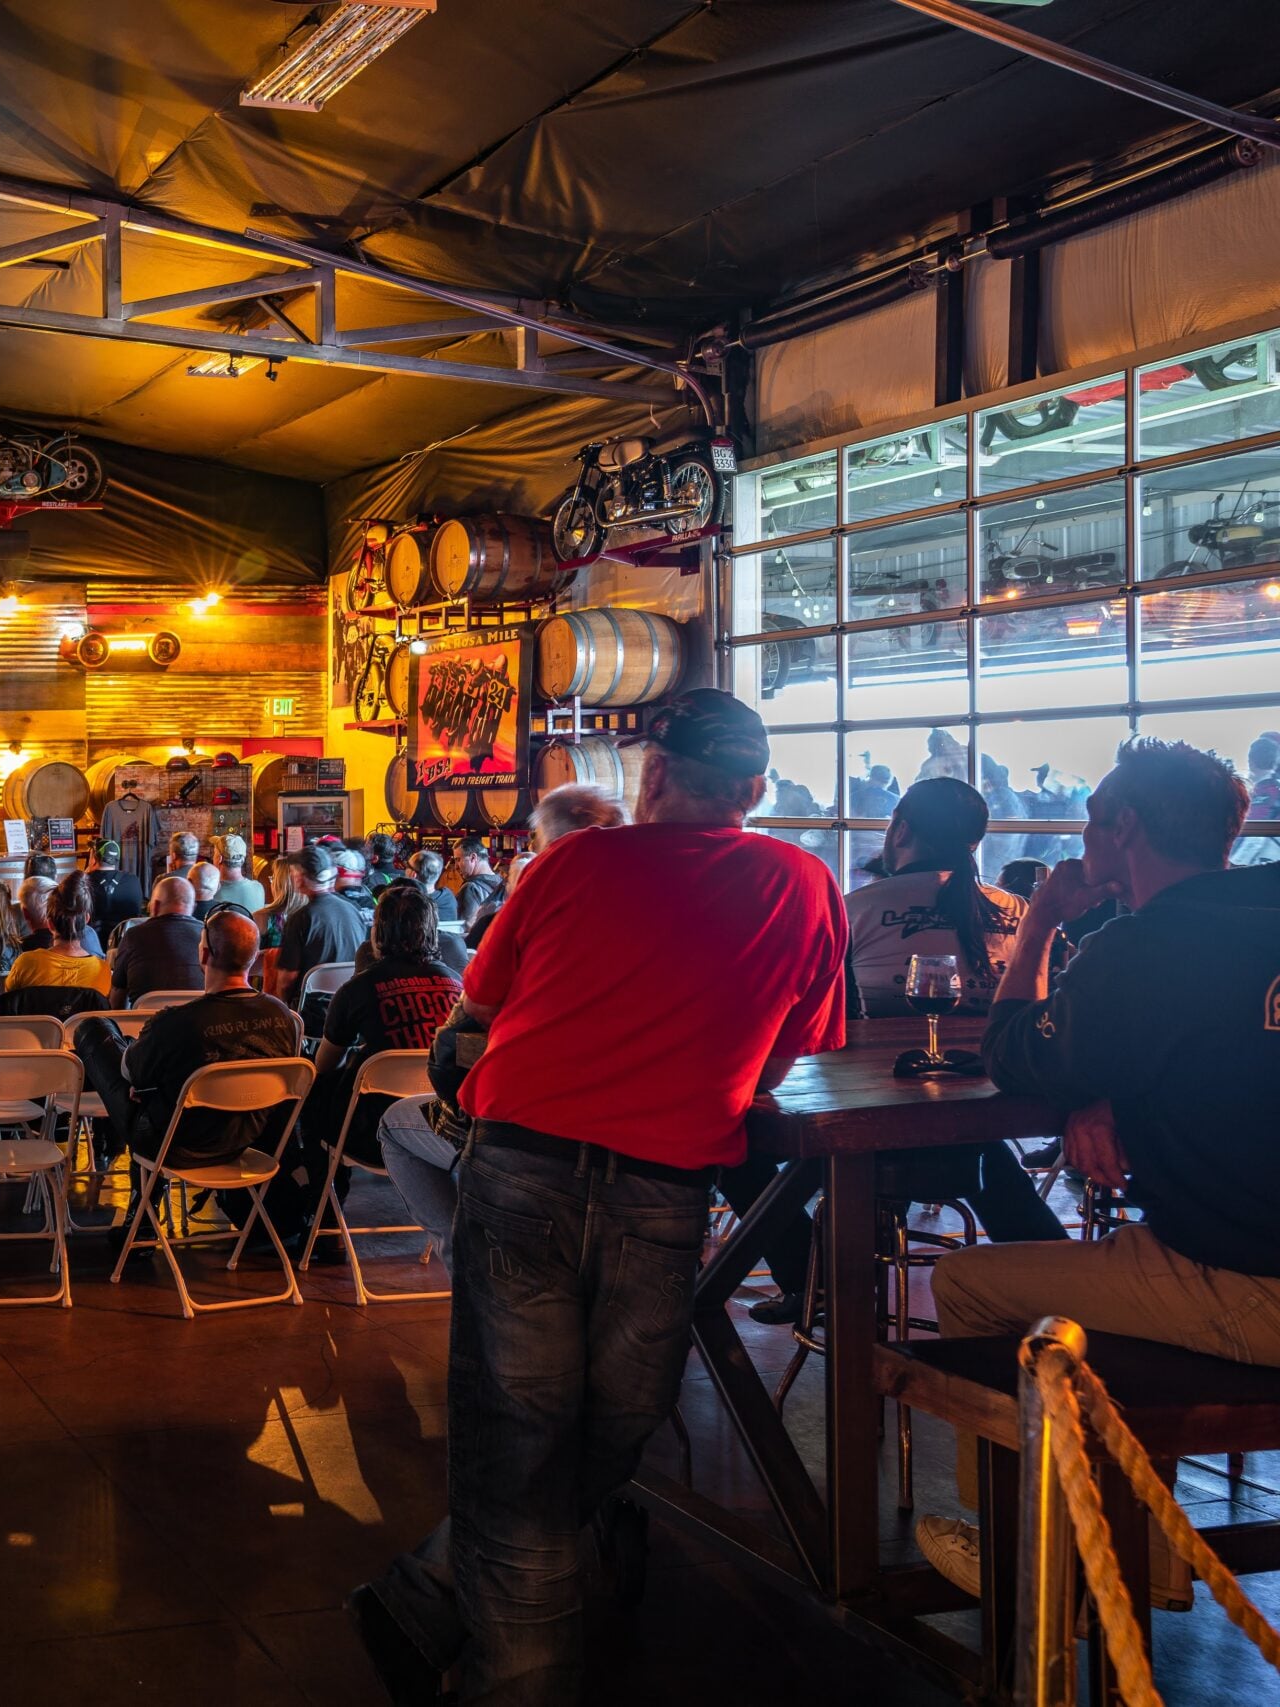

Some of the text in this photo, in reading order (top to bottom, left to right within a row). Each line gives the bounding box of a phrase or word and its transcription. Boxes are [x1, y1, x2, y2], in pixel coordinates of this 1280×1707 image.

[454, 635, 483, 650] ROSA
[487, 628, 519, 643] MILE
[490, 681, 505, 704] 24
[273, 698, 294, 715] EXIT
[427, 758, 452, 781] BSA
[451, 774, 516, 785] 1970 FREIGHT TRAIN
[376, 976, 432, 991] Malcolm
[252, 1017, 272, 1030] SAN
